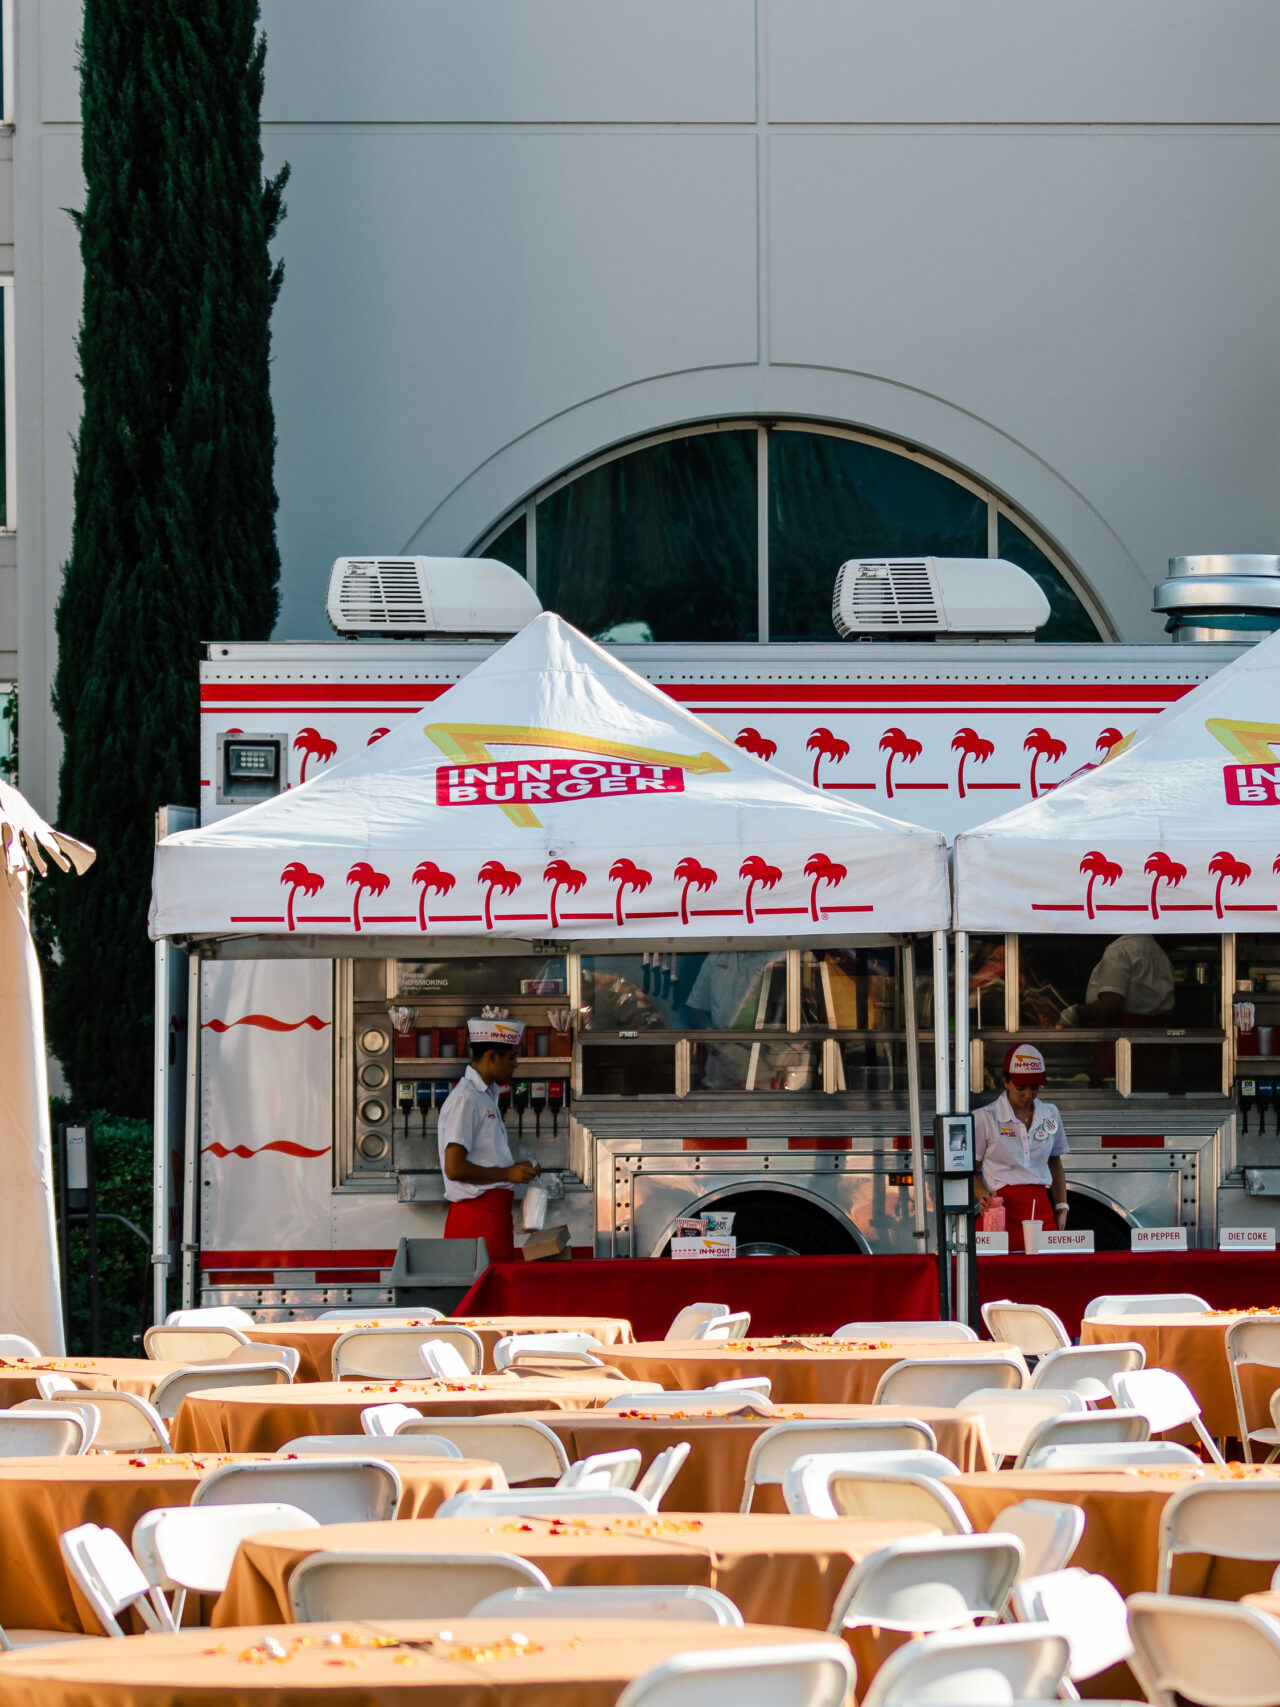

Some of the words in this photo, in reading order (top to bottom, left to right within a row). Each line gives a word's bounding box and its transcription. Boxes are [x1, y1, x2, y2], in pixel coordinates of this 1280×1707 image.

[448, 763, 670, 785] IN-N-OUT
[449, 776, 667, 803] BURGER
[1047, 1235, 1086, 1244] SEVEN-UP
[1137, 1233, 1149, 1241] DR
[1150, 1231, 1181, 1240] PEPPER
[1228, 1232, 1245, 1241] DIET
[1247, 1232, 1268, 1241] COKE
